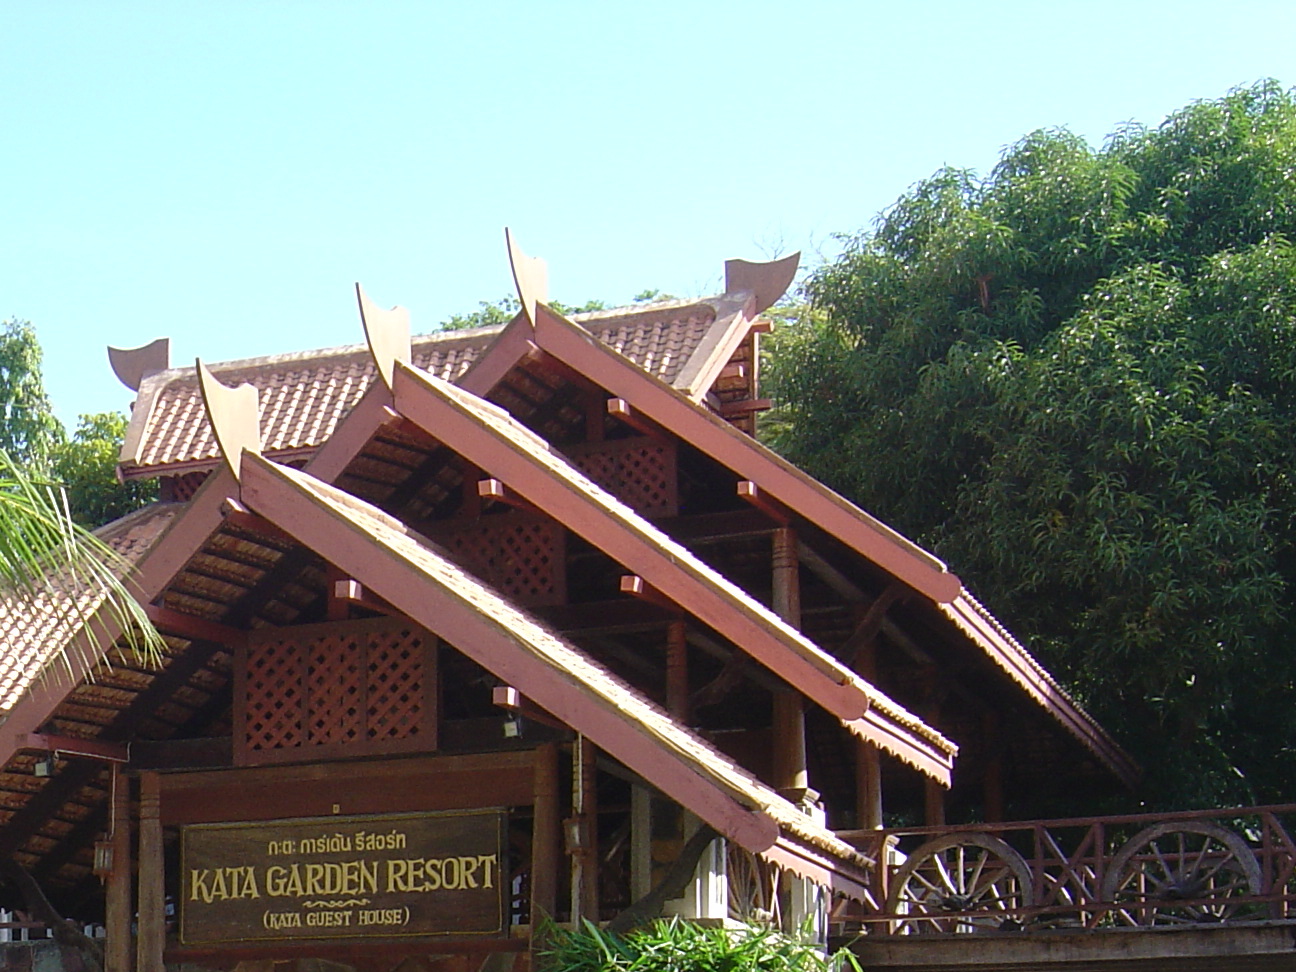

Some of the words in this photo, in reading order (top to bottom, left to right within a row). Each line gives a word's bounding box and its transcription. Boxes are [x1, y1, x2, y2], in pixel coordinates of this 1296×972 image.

[190, 866, 260, 904] KATA
[266, 859, 379, 898] GARDEN
[386, 854, 497, 893] RESORT
[263, 910, 302, 930] (KATA
[306, 910, 353, 927] GUEST
[358, 906, 410, 926] HOUSE)
